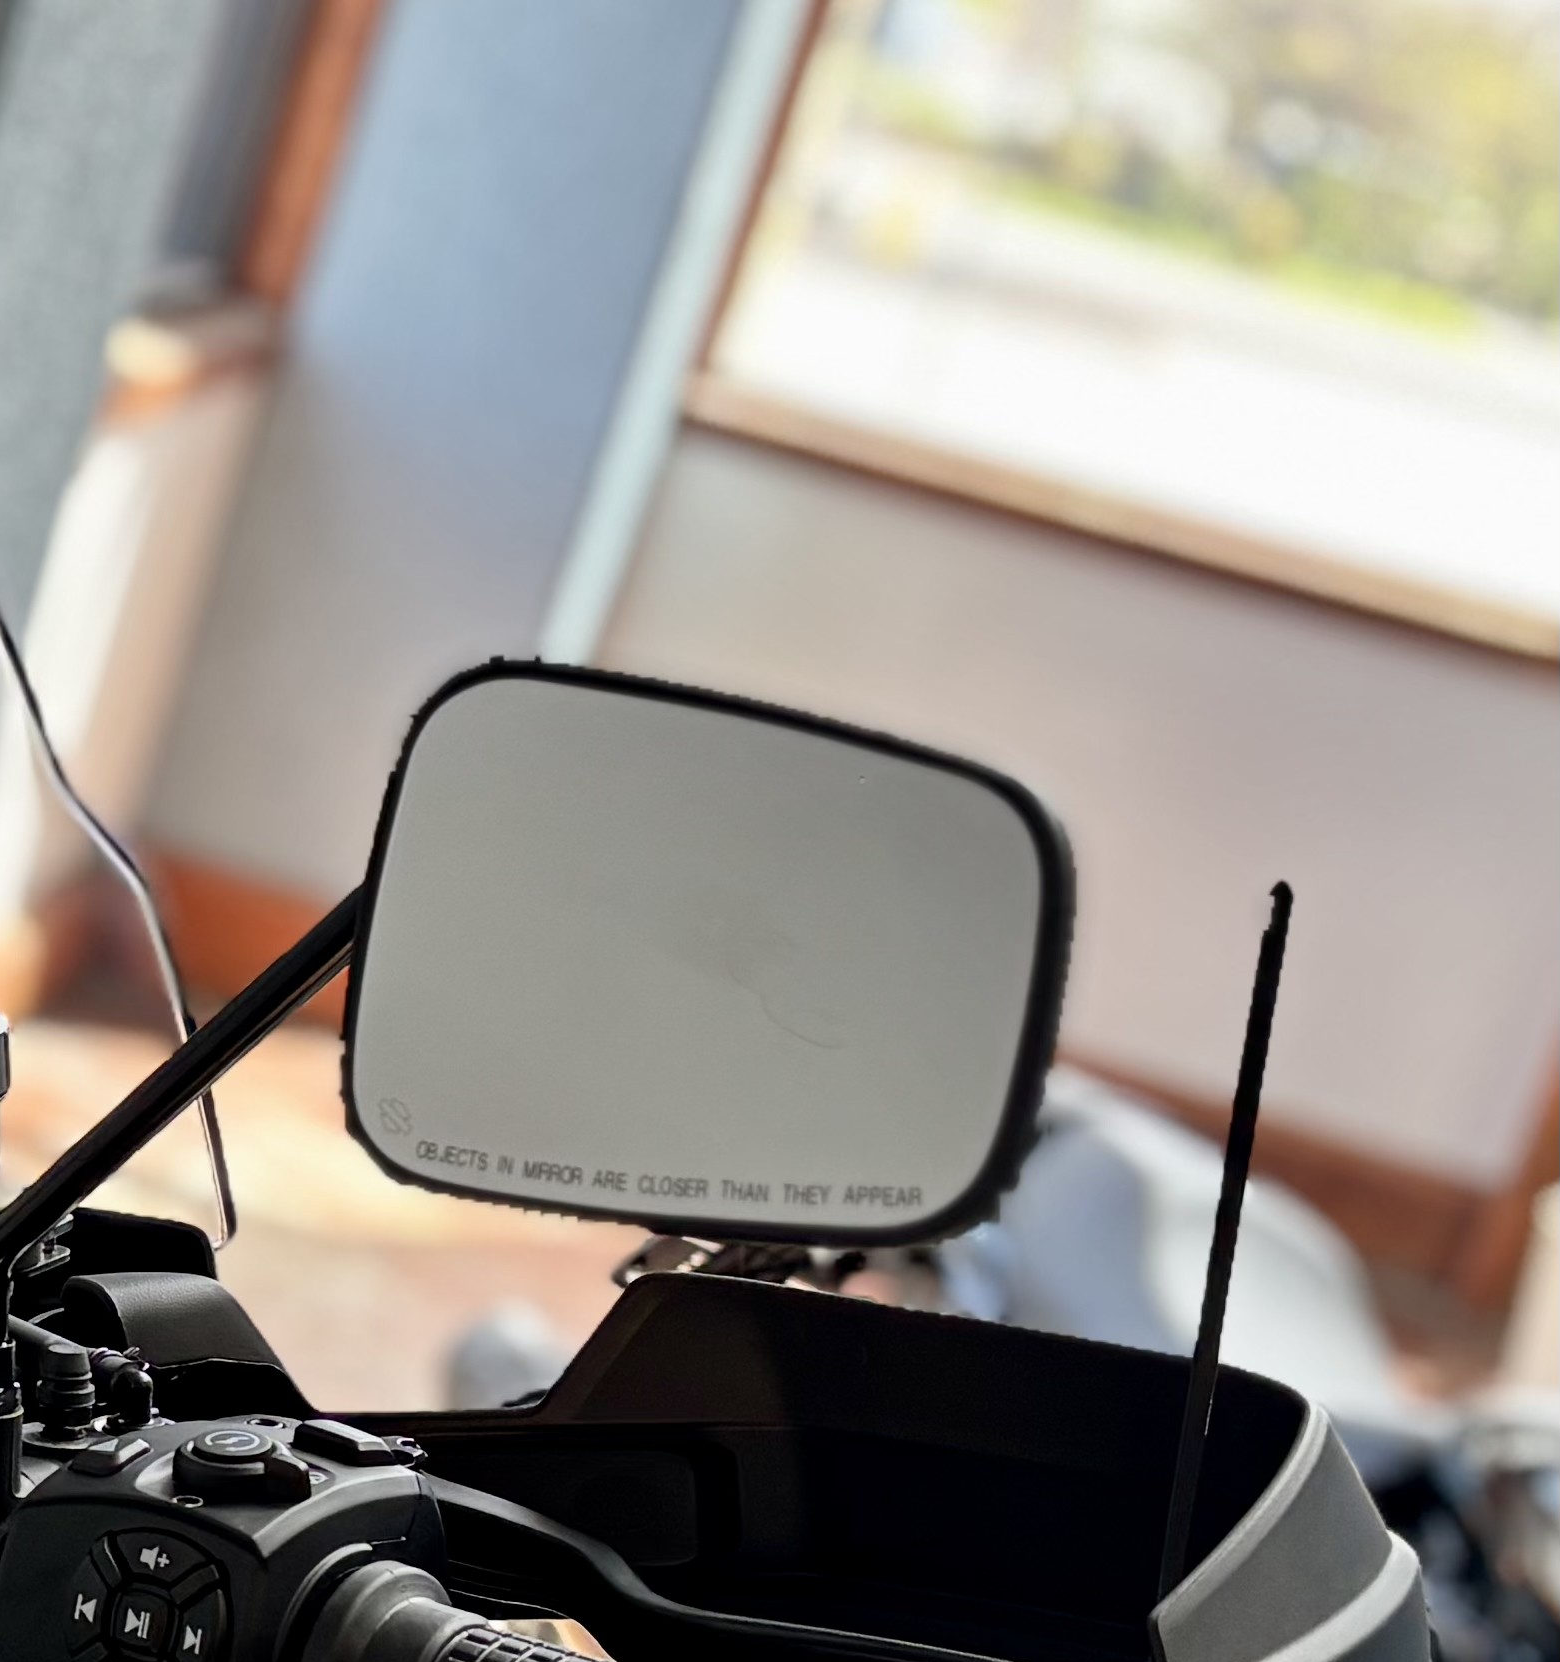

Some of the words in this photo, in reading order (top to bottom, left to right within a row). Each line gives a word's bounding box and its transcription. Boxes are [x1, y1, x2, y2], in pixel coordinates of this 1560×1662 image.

[416, 1140, 488, 1171] OBJECTS
[497, 1155, 514, 1175] IN
[522, 1160, 584, 1185] MIRROR
[591, 1169, 628, 1192] ARE
[637, 1172, 709, 1199] CLOSER
[721, 1178, 770, 1203] THAN
[784, 1182, 831, 1206] THEY
[842, 1185, 923, 1207] APPEAR
